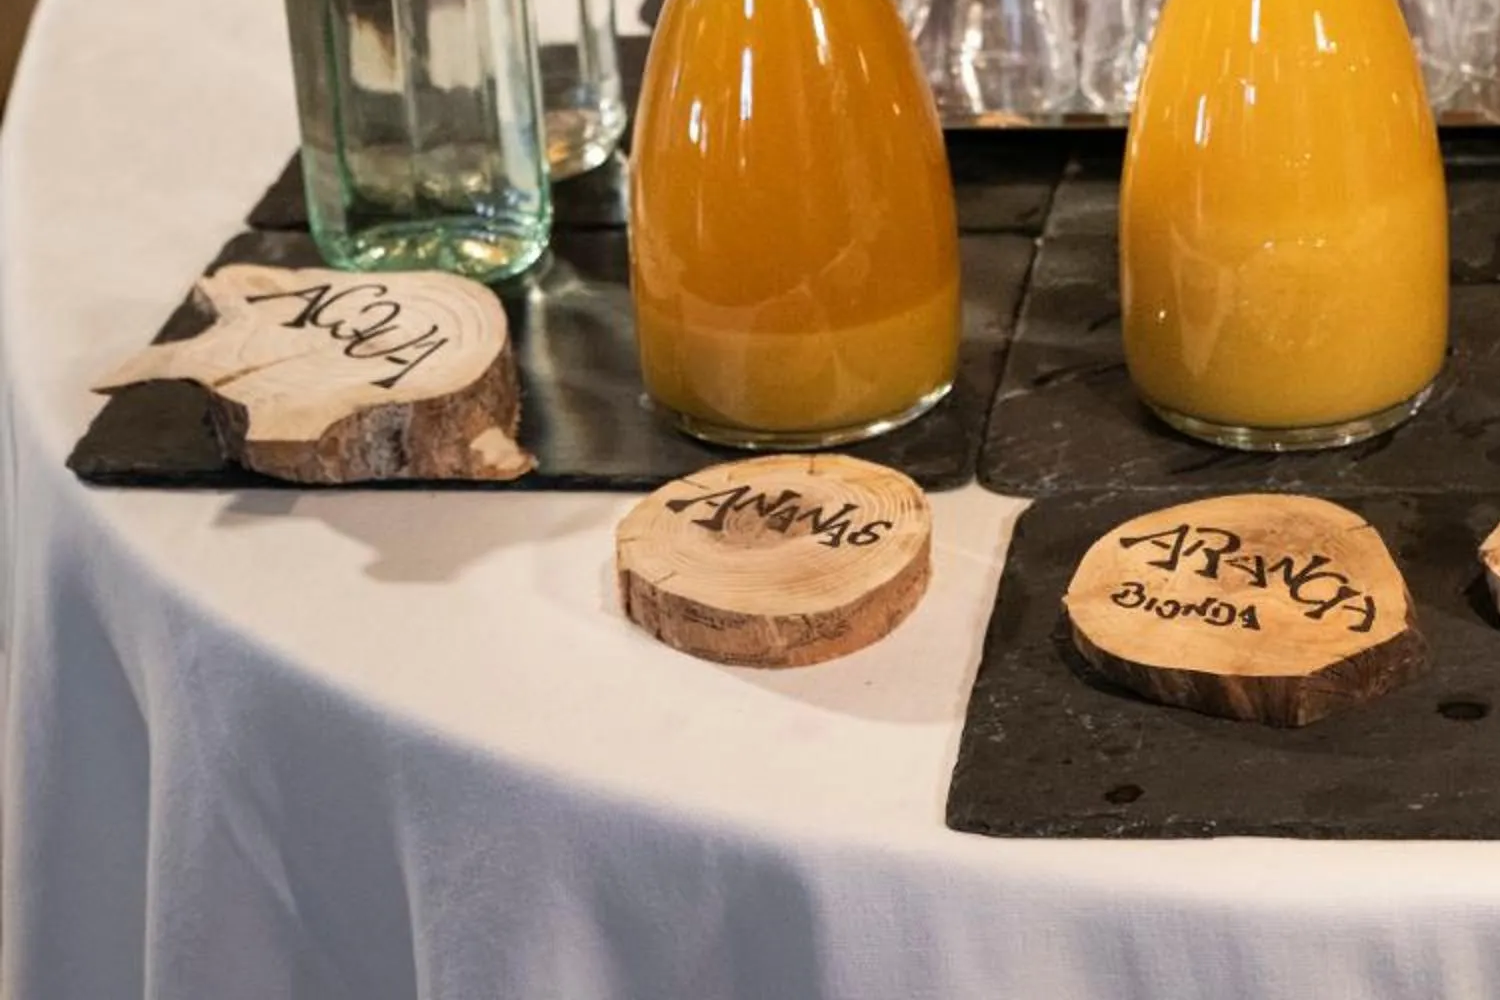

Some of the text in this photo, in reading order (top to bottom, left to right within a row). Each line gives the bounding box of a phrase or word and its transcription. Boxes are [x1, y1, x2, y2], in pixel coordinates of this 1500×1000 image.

[245, 283, 449, 389] ACQUA
[665, 485, 893, 548] ANANAS
[1110, 581, 1261, 631] BIONDA
